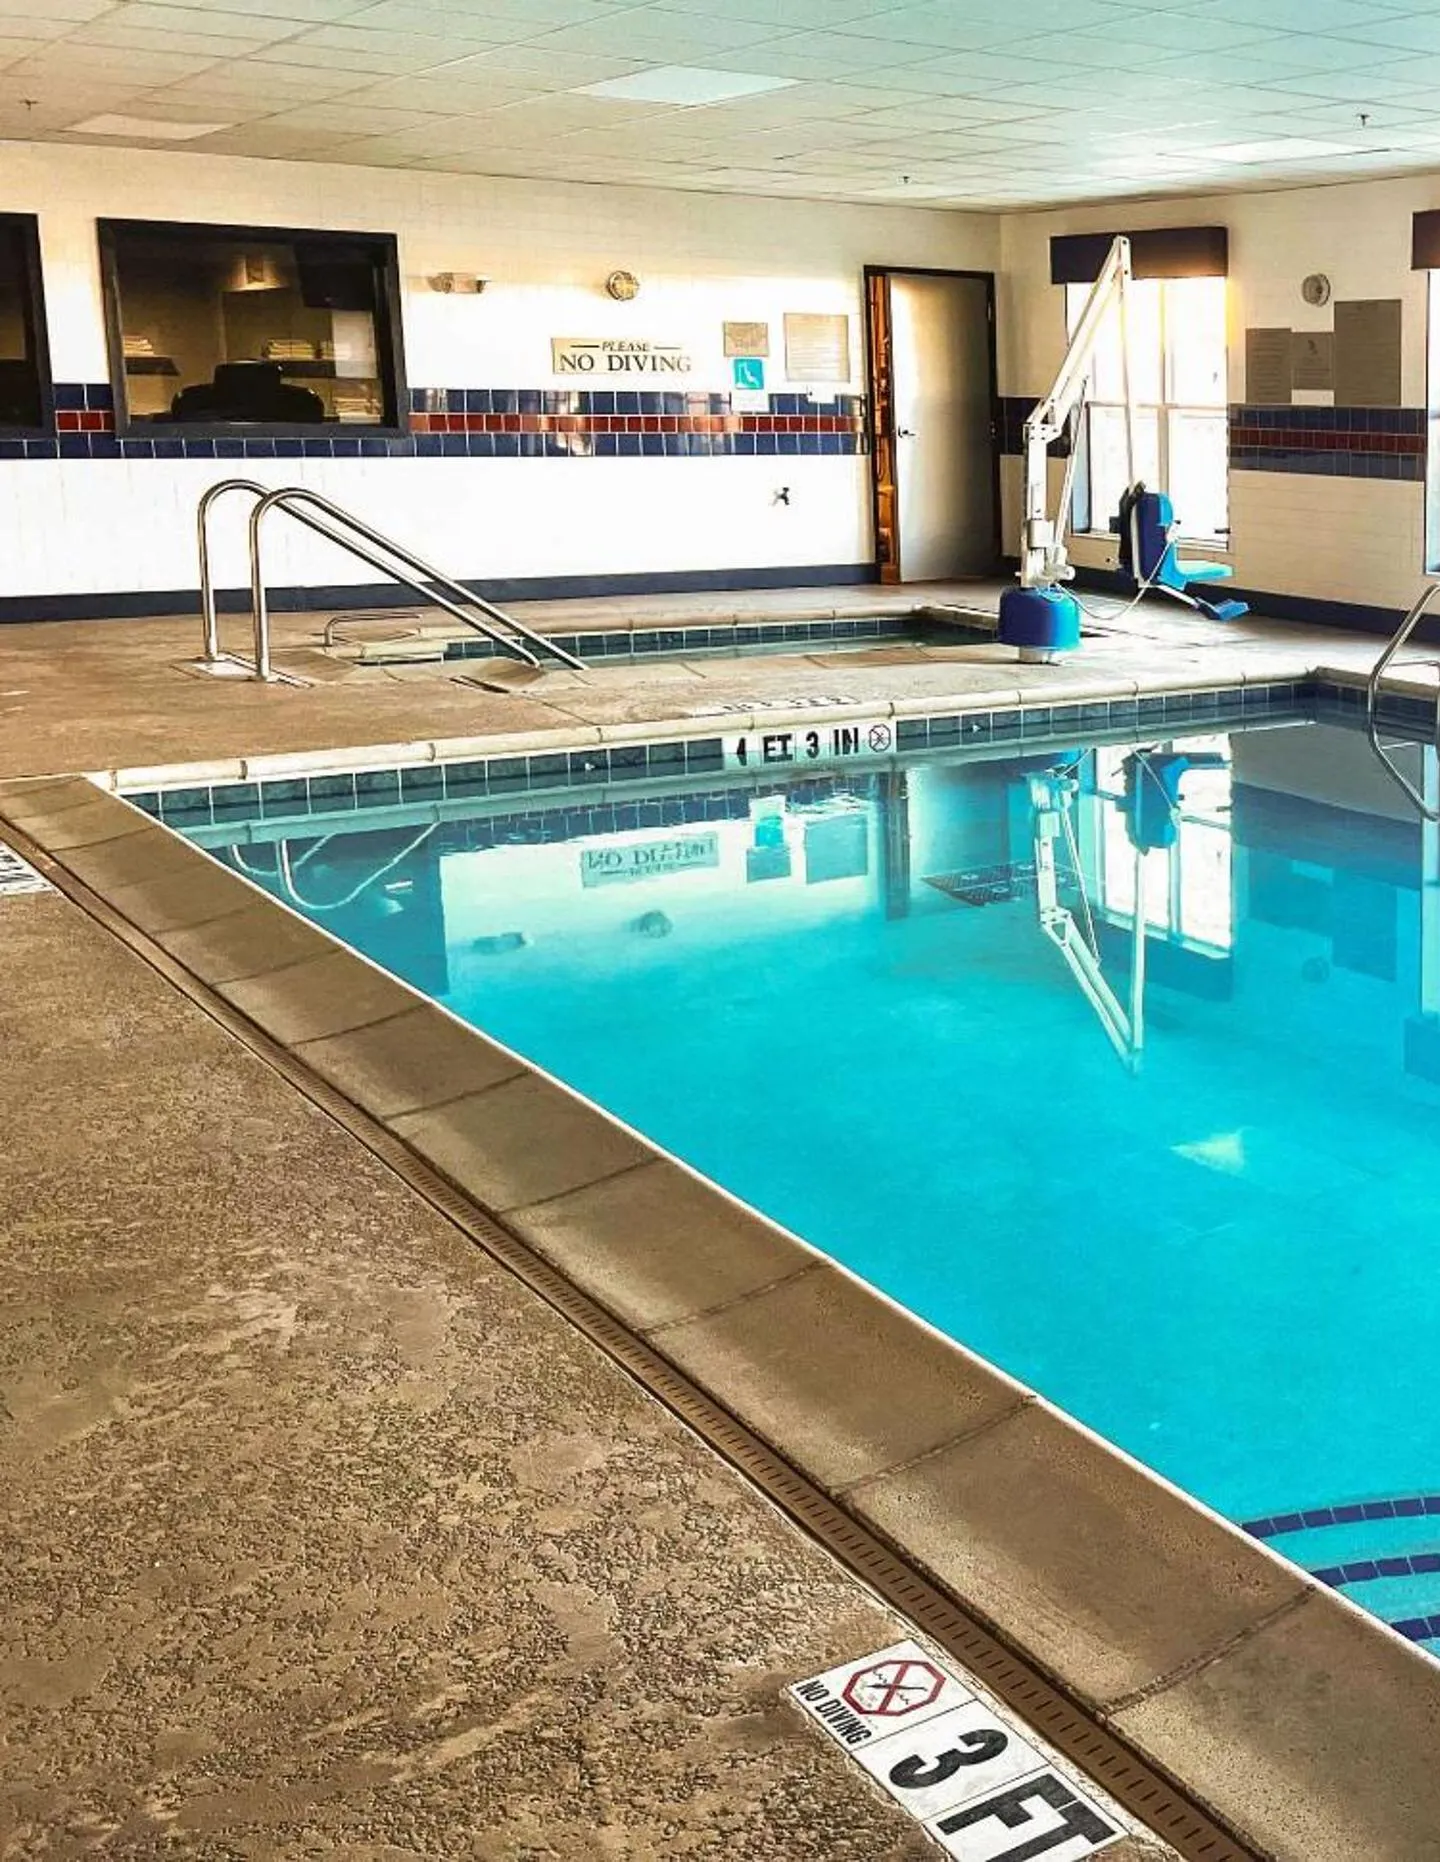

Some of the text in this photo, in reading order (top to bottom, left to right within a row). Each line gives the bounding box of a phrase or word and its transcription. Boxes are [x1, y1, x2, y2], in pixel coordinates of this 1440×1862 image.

[559, 353, 692, 372] NO DIVING
[602, 341, 650, 352] PLEASE
[805, 731, 820, 759] 3
[833, 727, 859, 756] IN
[795, 1679, 873, 1745] NO DIVING
[888, 1729, 1117, 1862] 3 FT
